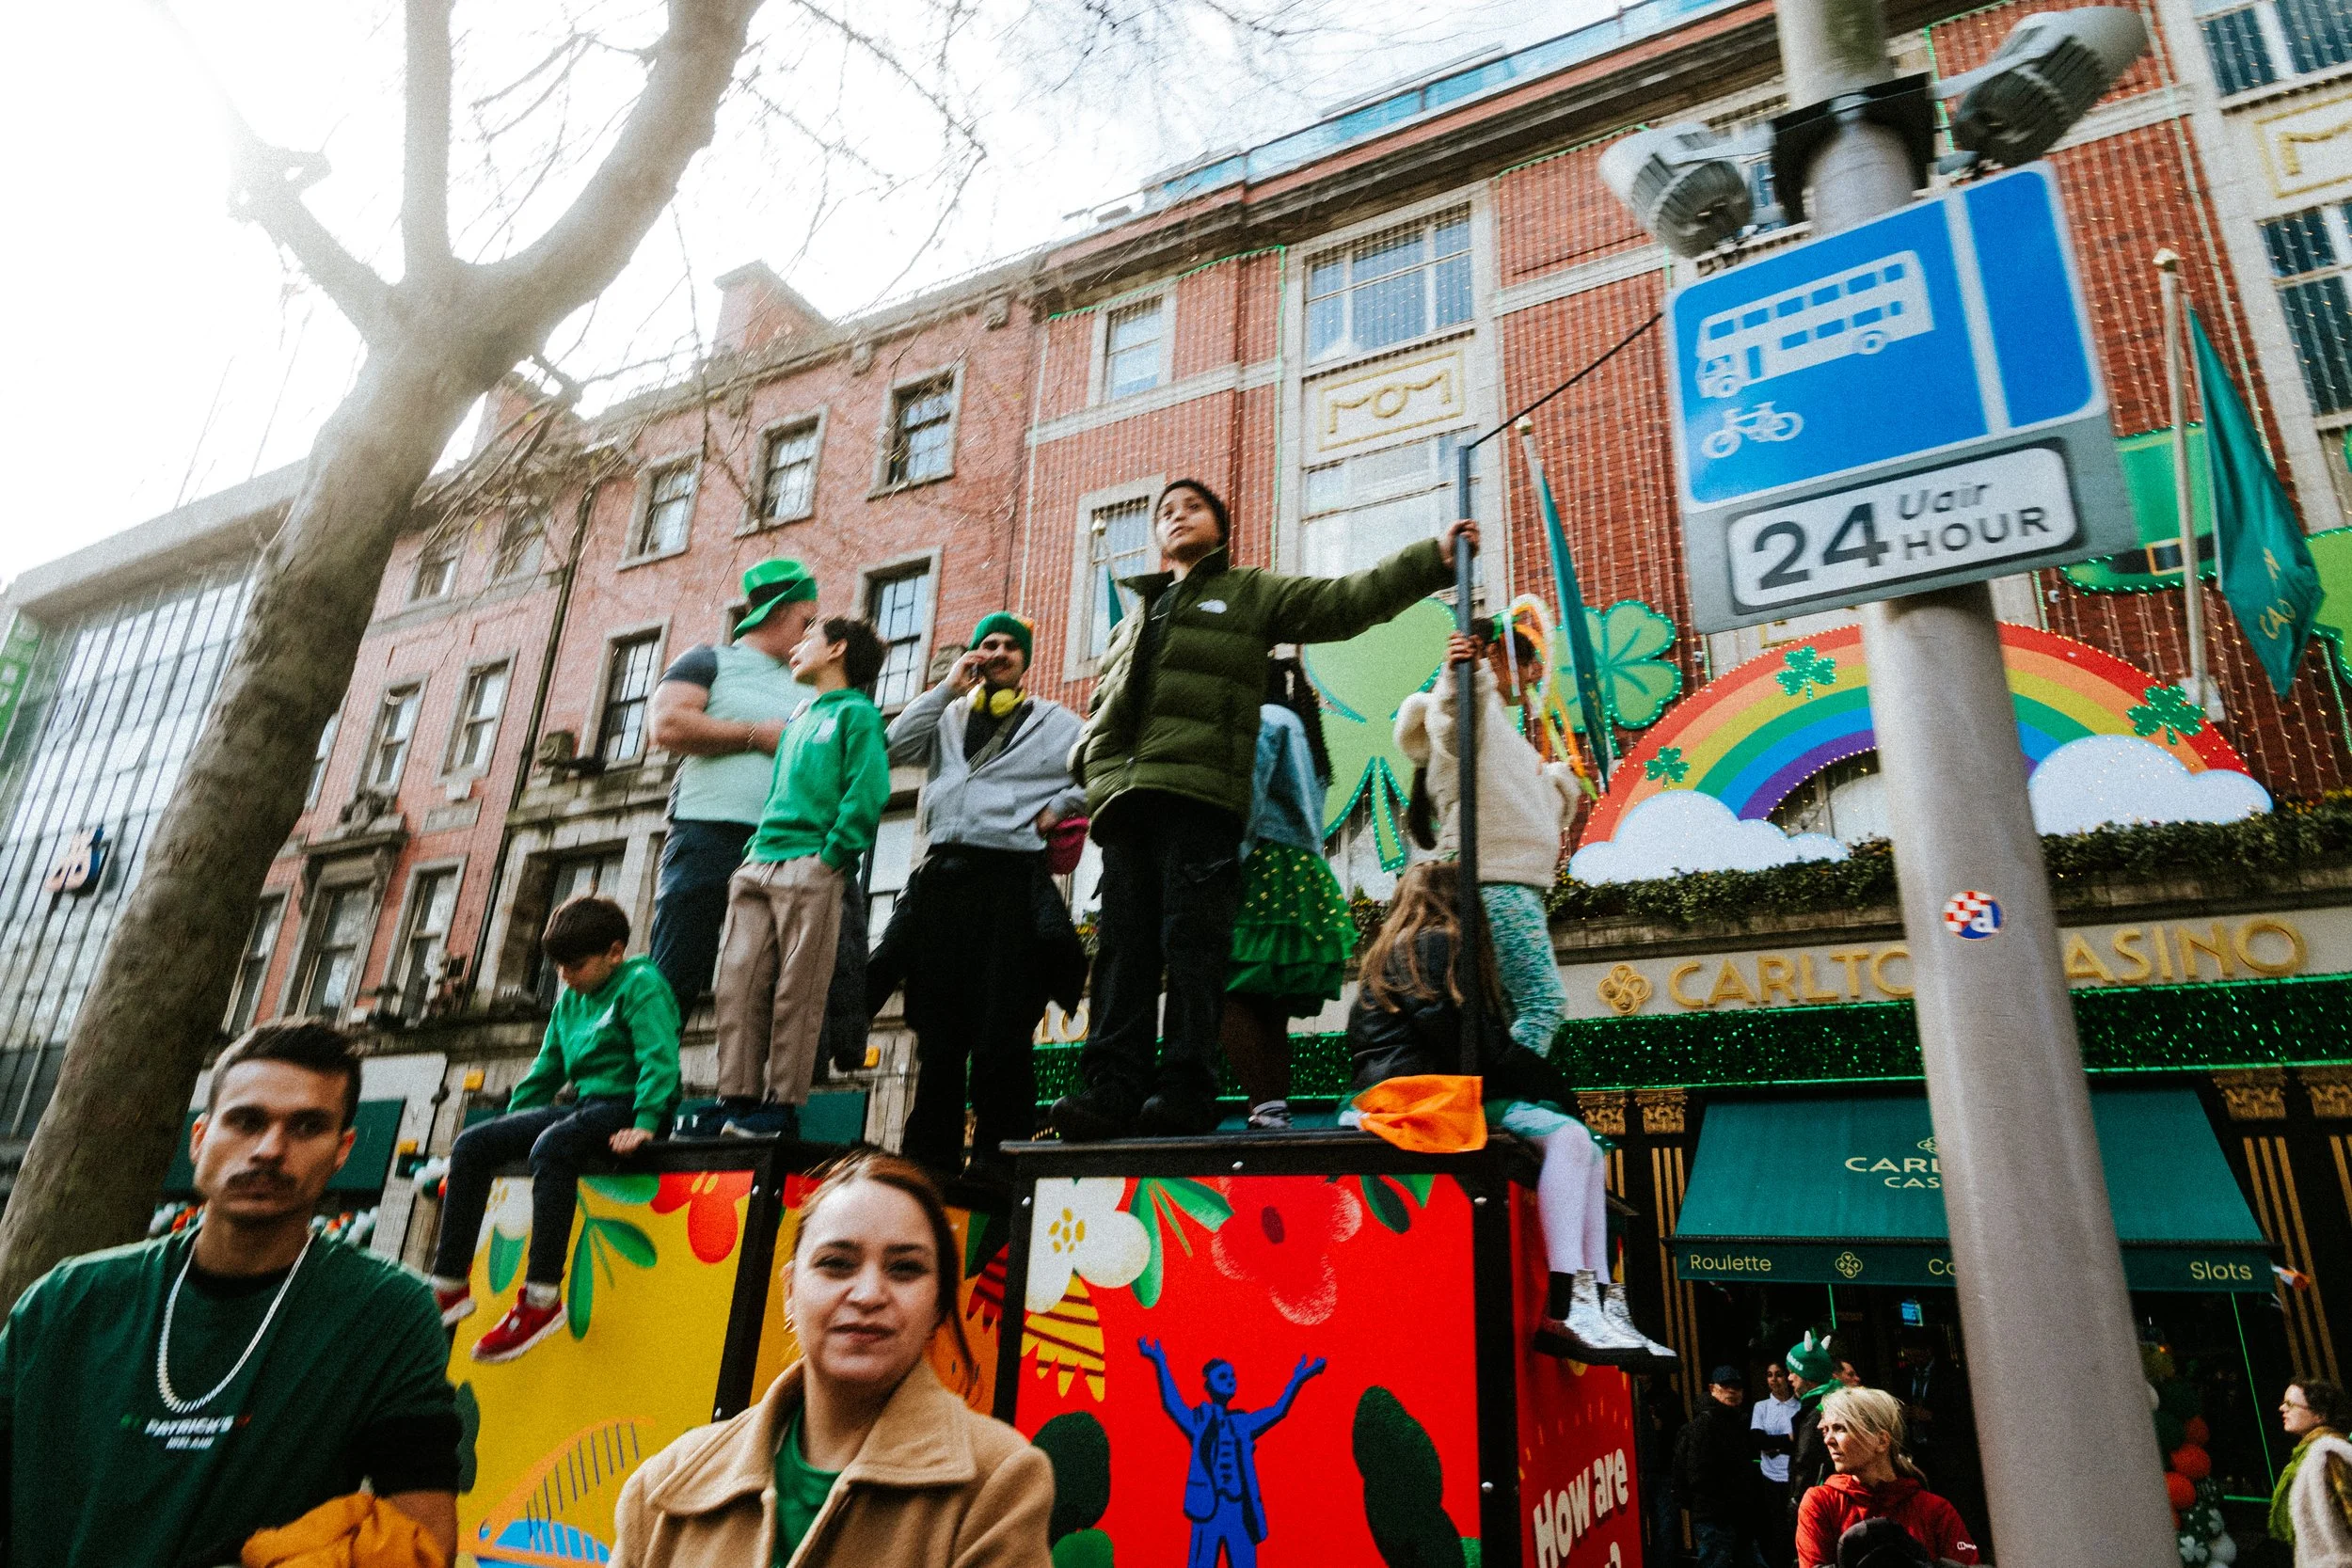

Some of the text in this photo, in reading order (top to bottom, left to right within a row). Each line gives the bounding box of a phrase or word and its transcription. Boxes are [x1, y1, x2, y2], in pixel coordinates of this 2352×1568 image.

[1898, 481, 1991, 521] Uair
[1752, 501, 1891, 591] 24
[1900, 506, 2052, 562] HOUR
[1667, 916, 2308, 1009] CARLTO ASINO
[1845, 1157, 1942, 1173] CARL
[1883, 1177, 1941, 1189] CAS
[1690, 1254, 1772, 1272] Roulette
[2189, 1260, 2252, 1280] Slots
[1533, 1449, 1629, 1568] How are
